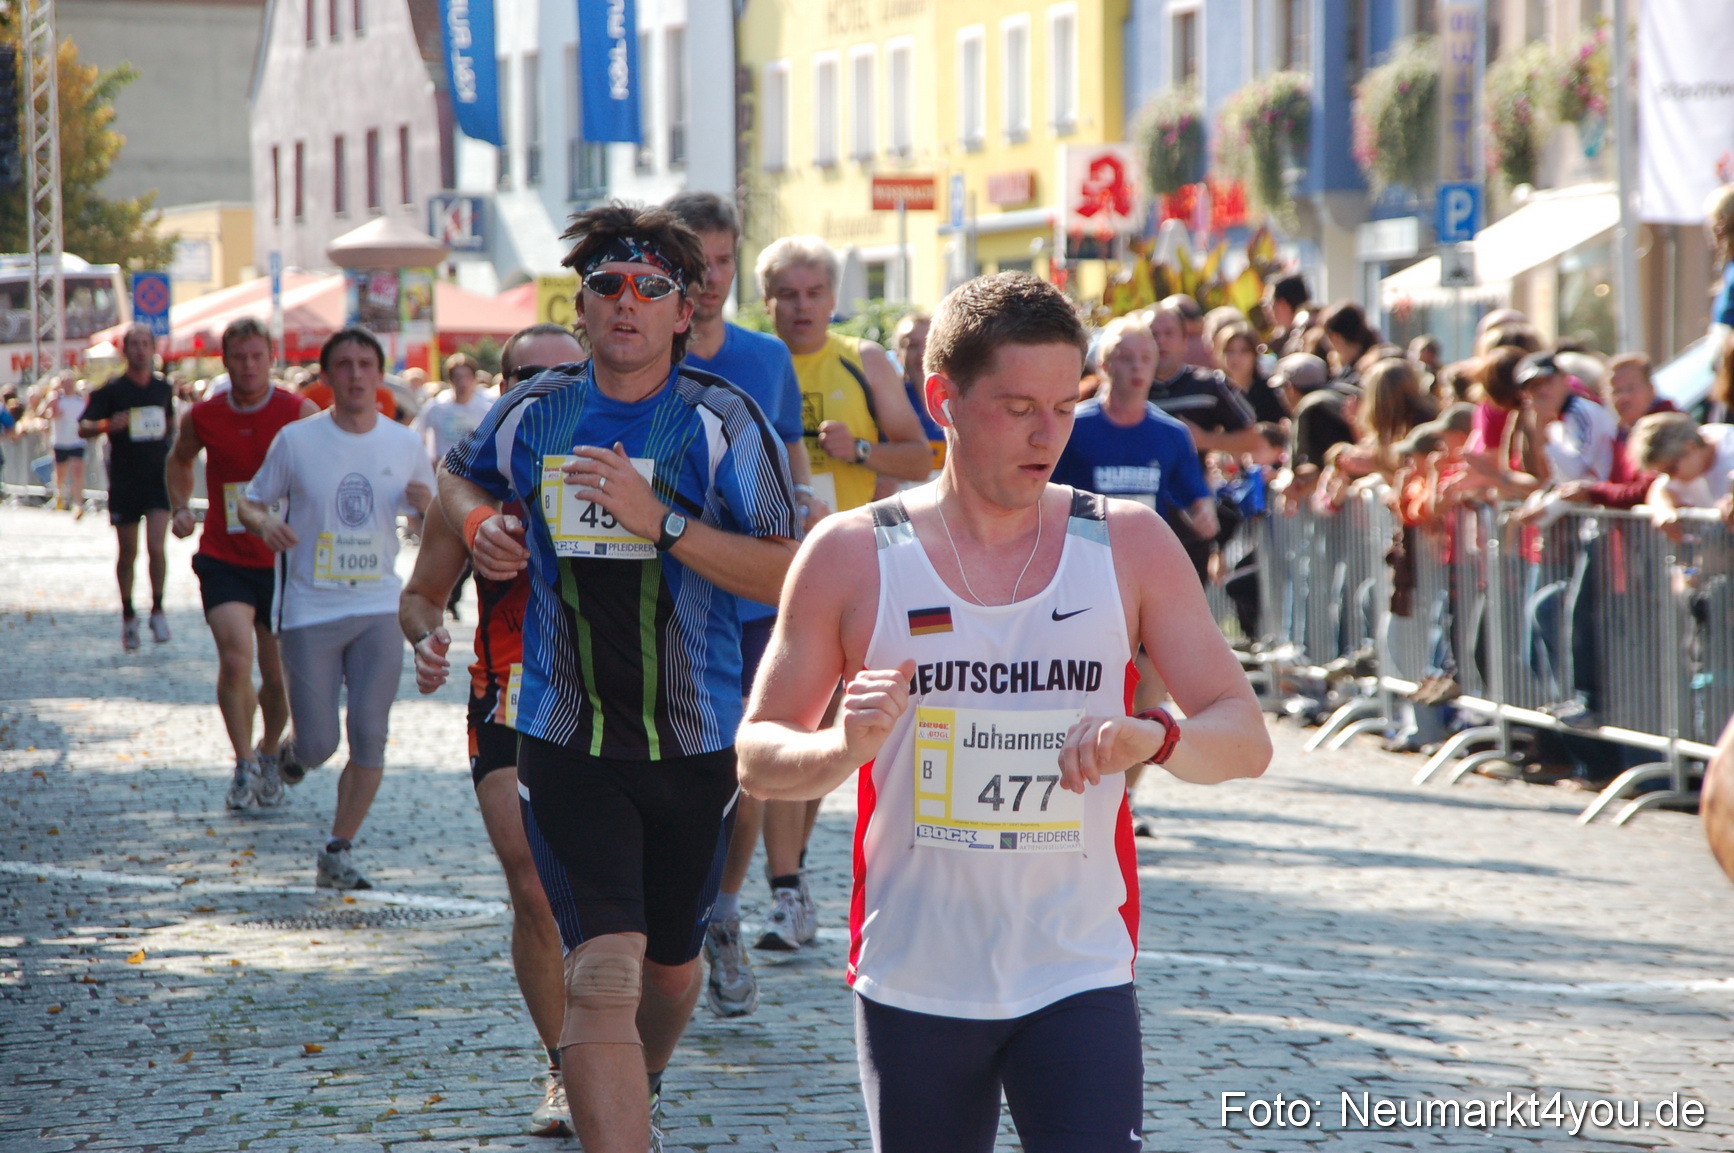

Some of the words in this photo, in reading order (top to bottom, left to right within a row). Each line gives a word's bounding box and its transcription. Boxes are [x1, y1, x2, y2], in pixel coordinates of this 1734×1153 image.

[1448, 188, 1473, 237] P
[608, 542, 655, 552] PFLEIDERER
[337, 553, 378, 569] 1009
[963, 722, 1067, 750] Johannes
[922, 760, 933, 779] B
[977, 774, 1060, 812] 477
[917, 824, 977, 843] BOCK
[1019, 830, 1081, 843] PFLEIDERER
